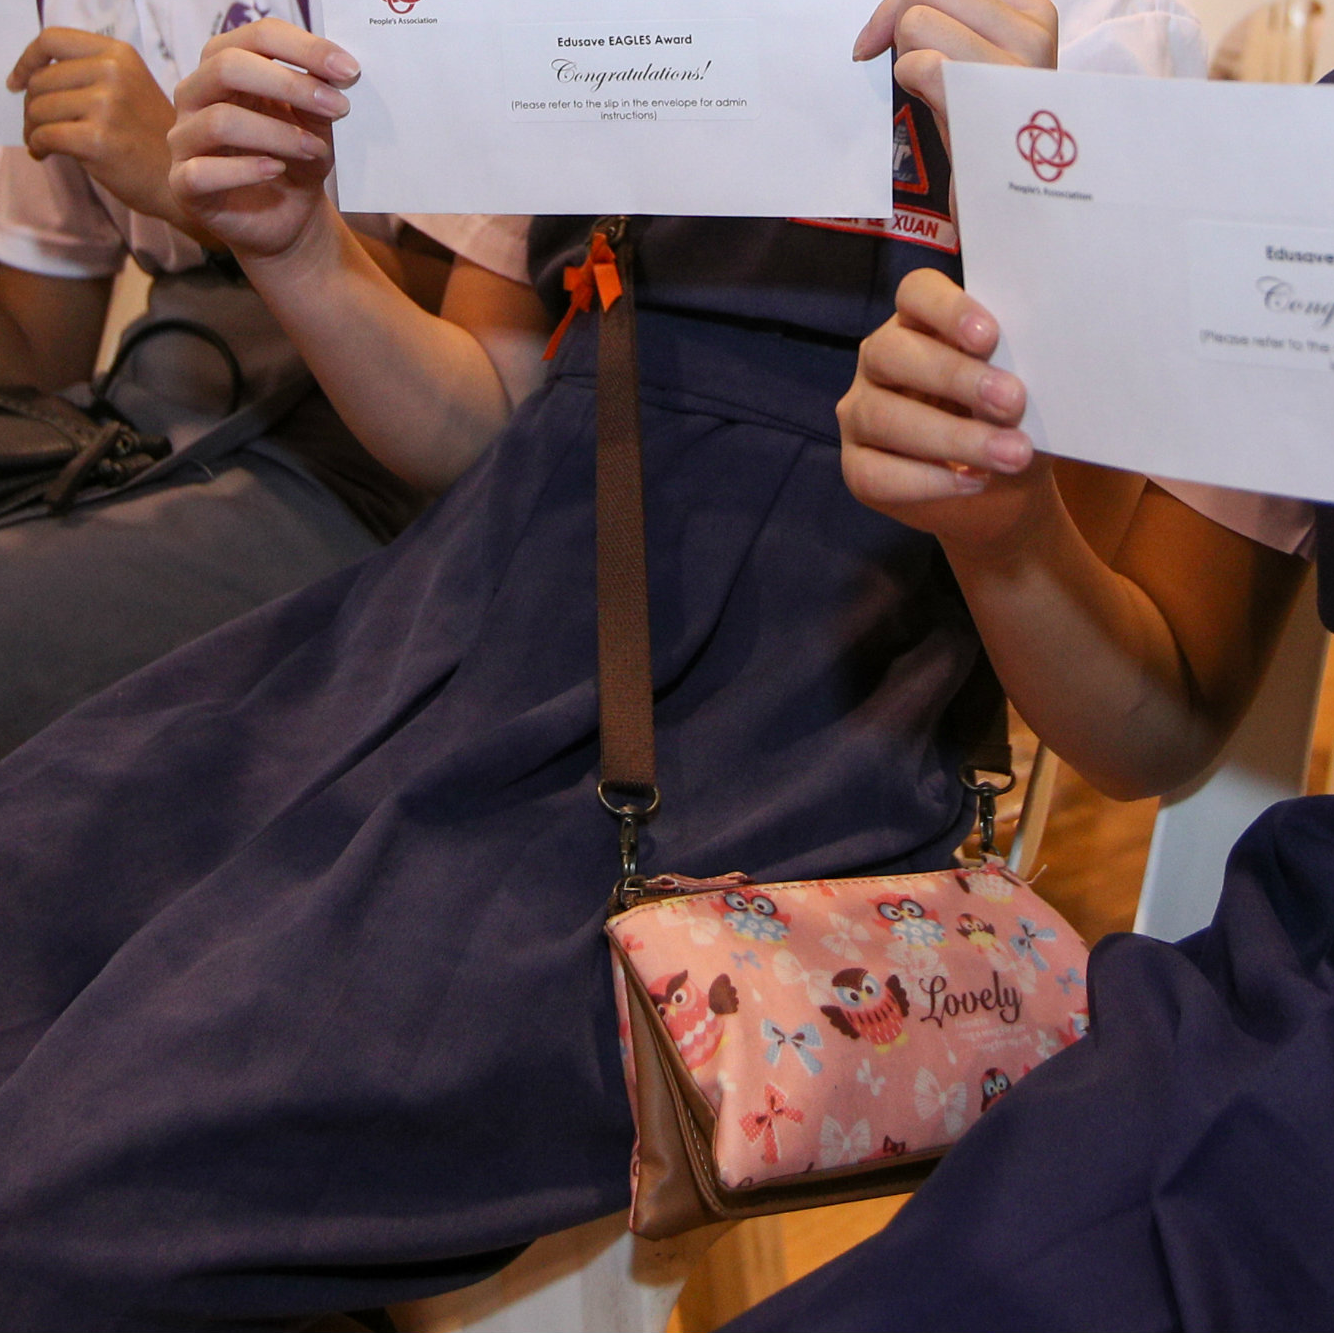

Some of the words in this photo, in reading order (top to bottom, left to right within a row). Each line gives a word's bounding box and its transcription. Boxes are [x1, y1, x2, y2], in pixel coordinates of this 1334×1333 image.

[369, 17, 396, 26] People's
[398, 17, 438, 25] Association
[557, 36, 605, 48] Edusave
[609, 35, 651, 46] EAGLES
[655, 34, 692, 45] Award
[551, 59, 712, 92] Congratulations!
[511, 100, 546, 111] (Please
[548, 100, 571, 110] refer
[573, 100, 583, 109] to
[585, 99, 602, 109] the
[604, 99, 619, 111] slip
[621, 99, 630, 108] in
[632, 99, 649, 108] the
[651, 98, 697, 110] envelope
[700, 98, 713, 107] for
[715, 97, 747, 107] admin
[600, 111, 657, 121] instructions)
[892, 214, 940, 239] XUAN
[919, 970, 1023, 1029] Lovely
